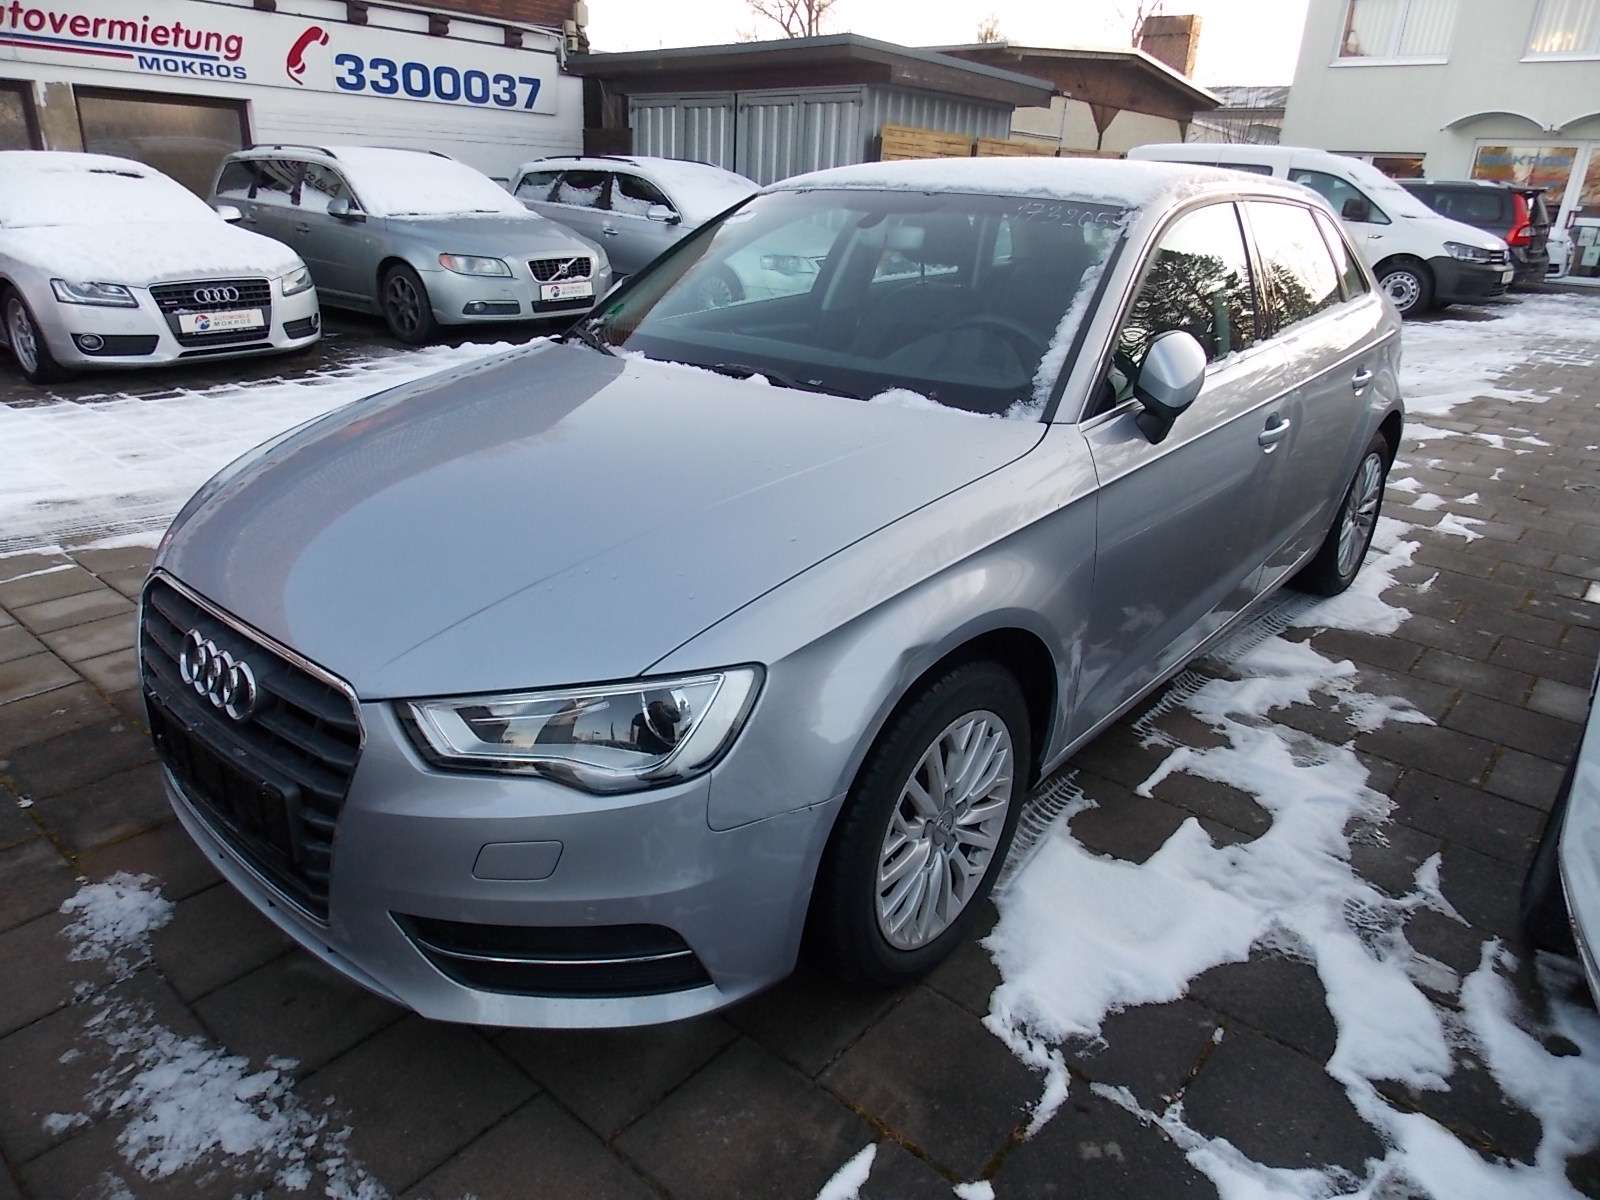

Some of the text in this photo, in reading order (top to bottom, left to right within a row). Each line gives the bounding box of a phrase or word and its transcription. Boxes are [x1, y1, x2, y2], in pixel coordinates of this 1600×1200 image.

[0, 0, 243, 61] tovermietung
[138, 55, 248, 80] MOKROS
[335, 53, 541, 109] 3300037
